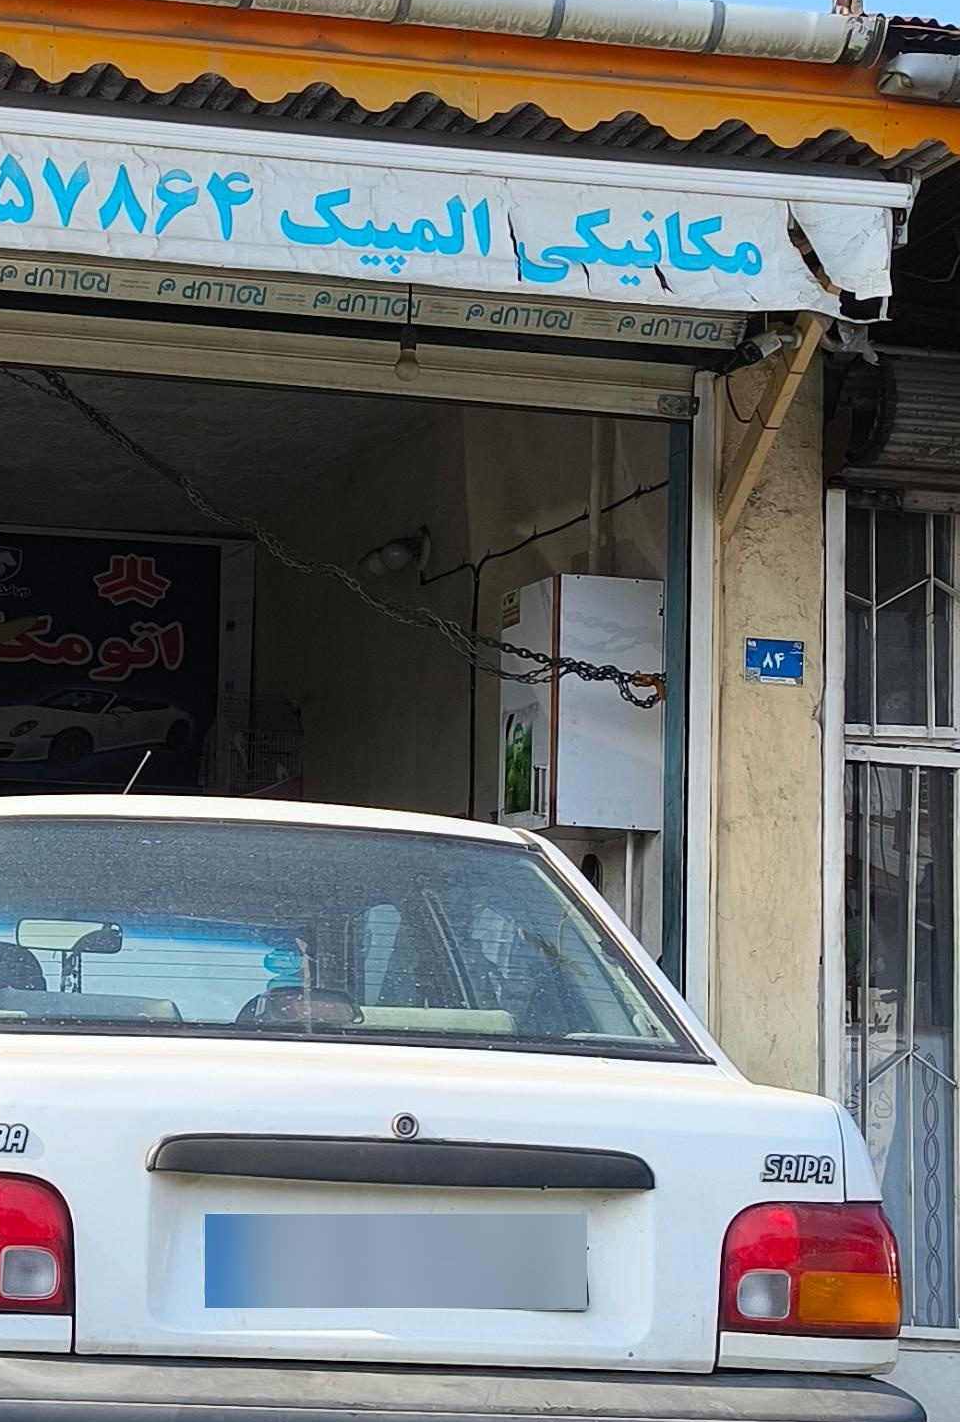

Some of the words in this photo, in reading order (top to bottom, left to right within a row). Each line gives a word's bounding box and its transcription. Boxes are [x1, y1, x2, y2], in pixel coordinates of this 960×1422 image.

[280, 187, 490, 275] المپیک
[518, 208, 764, 288] مکانیکی
[25, 266, 111, 294] ROLLUP
[181, 279, 268, 308] ROLLUP
[336, 289, 421, 318] ROLLUP
[489, 303, 573, 332] ROLLUP
[640, 316, 723, 343] ROLLUP
[762, 651, 785, 669] ۸۴
[760, 1153, 836, 1184] SAIPA
